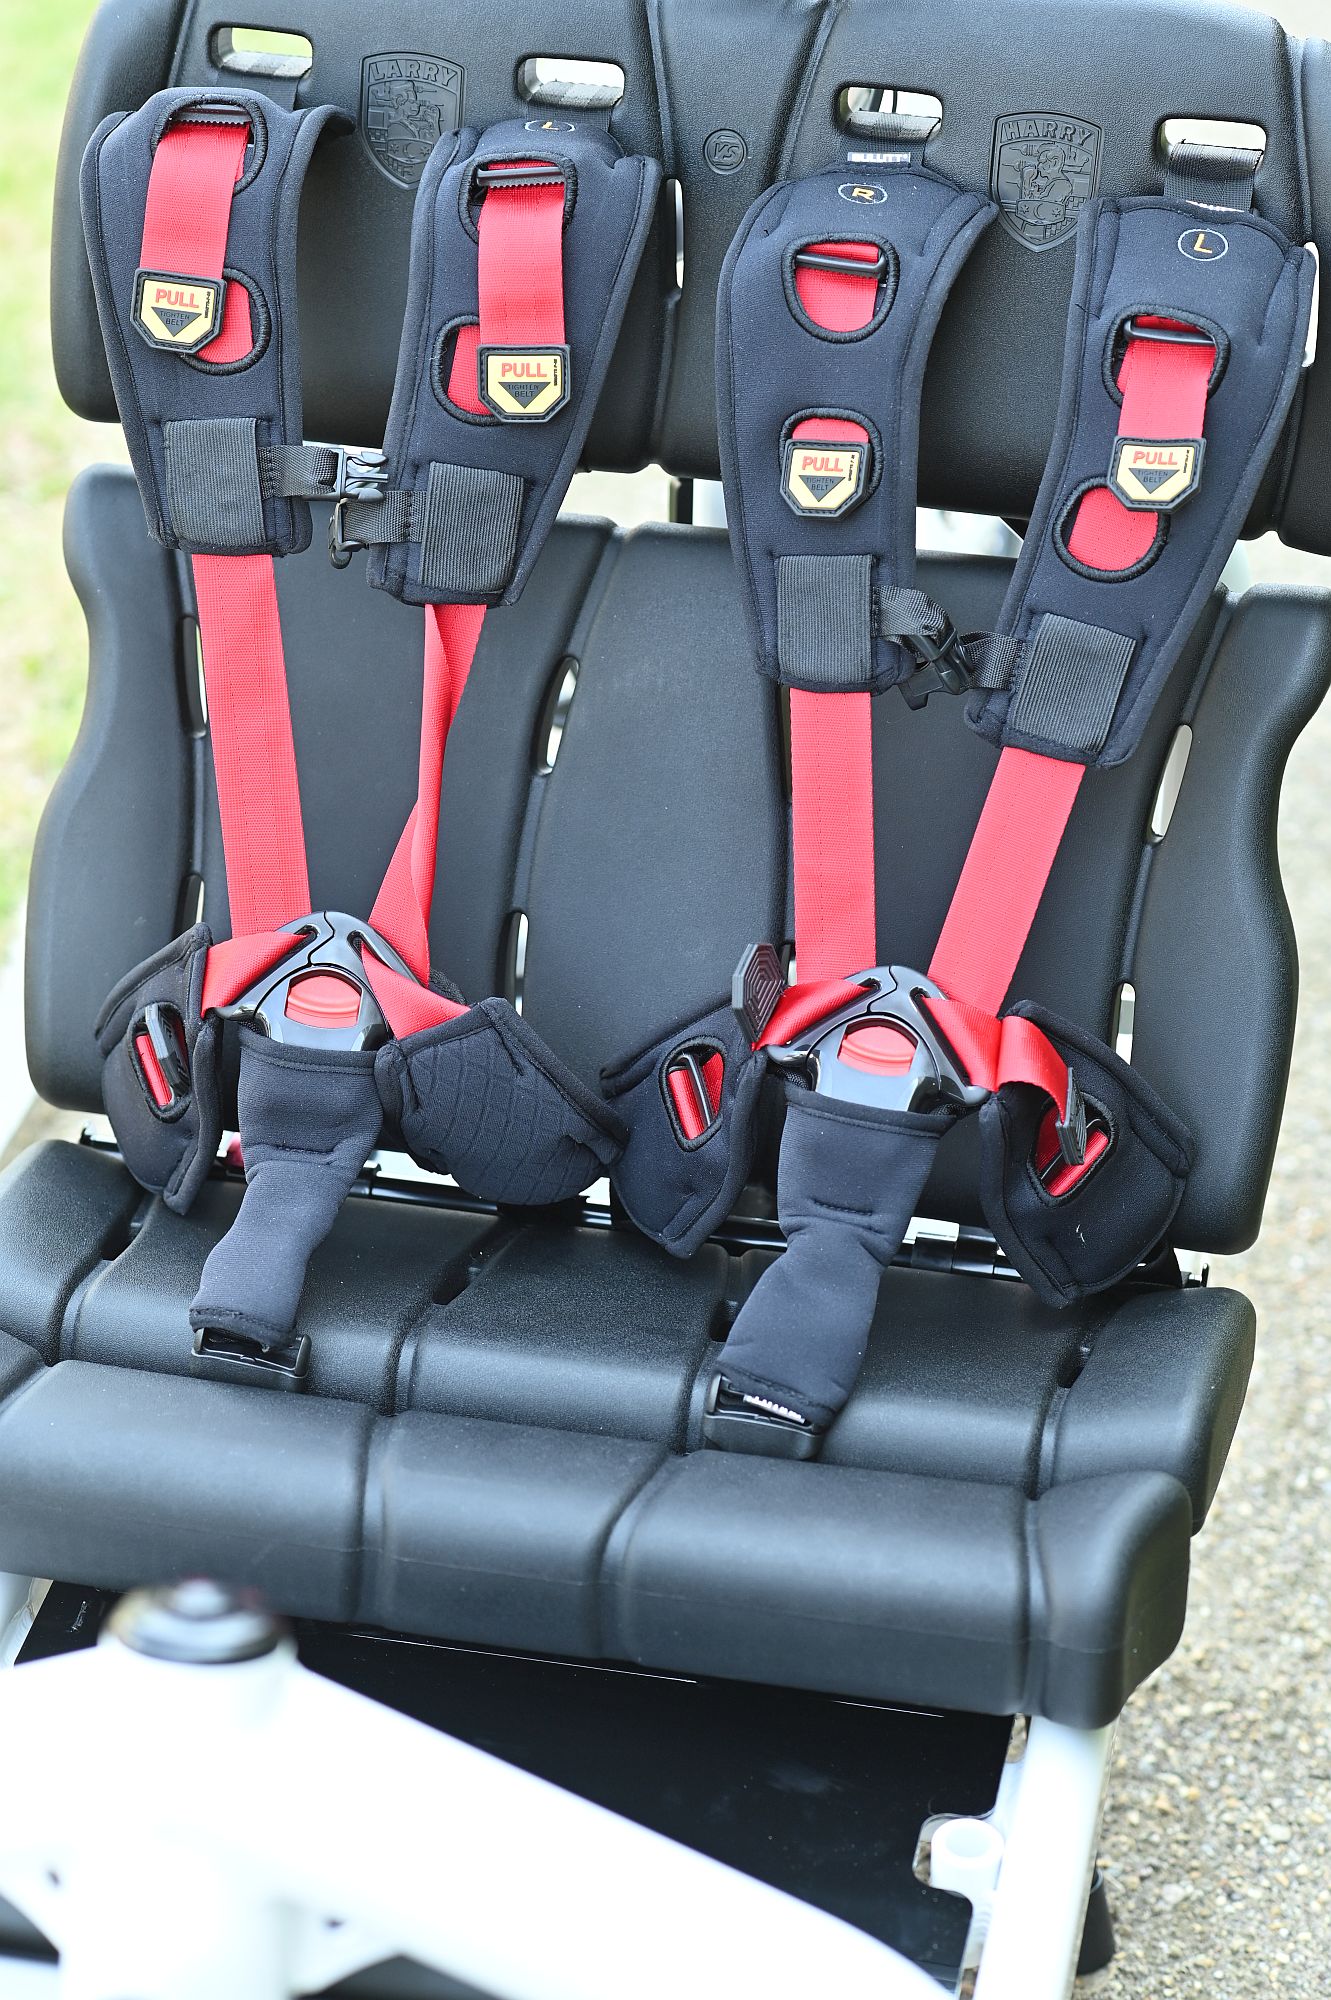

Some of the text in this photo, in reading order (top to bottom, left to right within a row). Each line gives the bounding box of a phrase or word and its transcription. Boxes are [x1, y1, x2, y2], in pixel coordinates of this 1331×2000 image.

[368, 60, 458, 86] LARRY
[1000, 120, 1094, 146] HARRY
[851, 187, 875, 201] R
[1194, 233, 1213, 254] L
[155, 288, 200, 309] PULL
[160, 310, 191, 320] TIGHTEN
[165, 317, 184, 326] BELT
[501, 362, 548, 378] PULL
[514, 390, 535, 398] BELT
[801, 455, 844, 473] PULL
[1132, 450, 1179, 466] PULL
[806, 477, 835, 485] TIGHTEN
[811, 483, 829, 491] BELT
